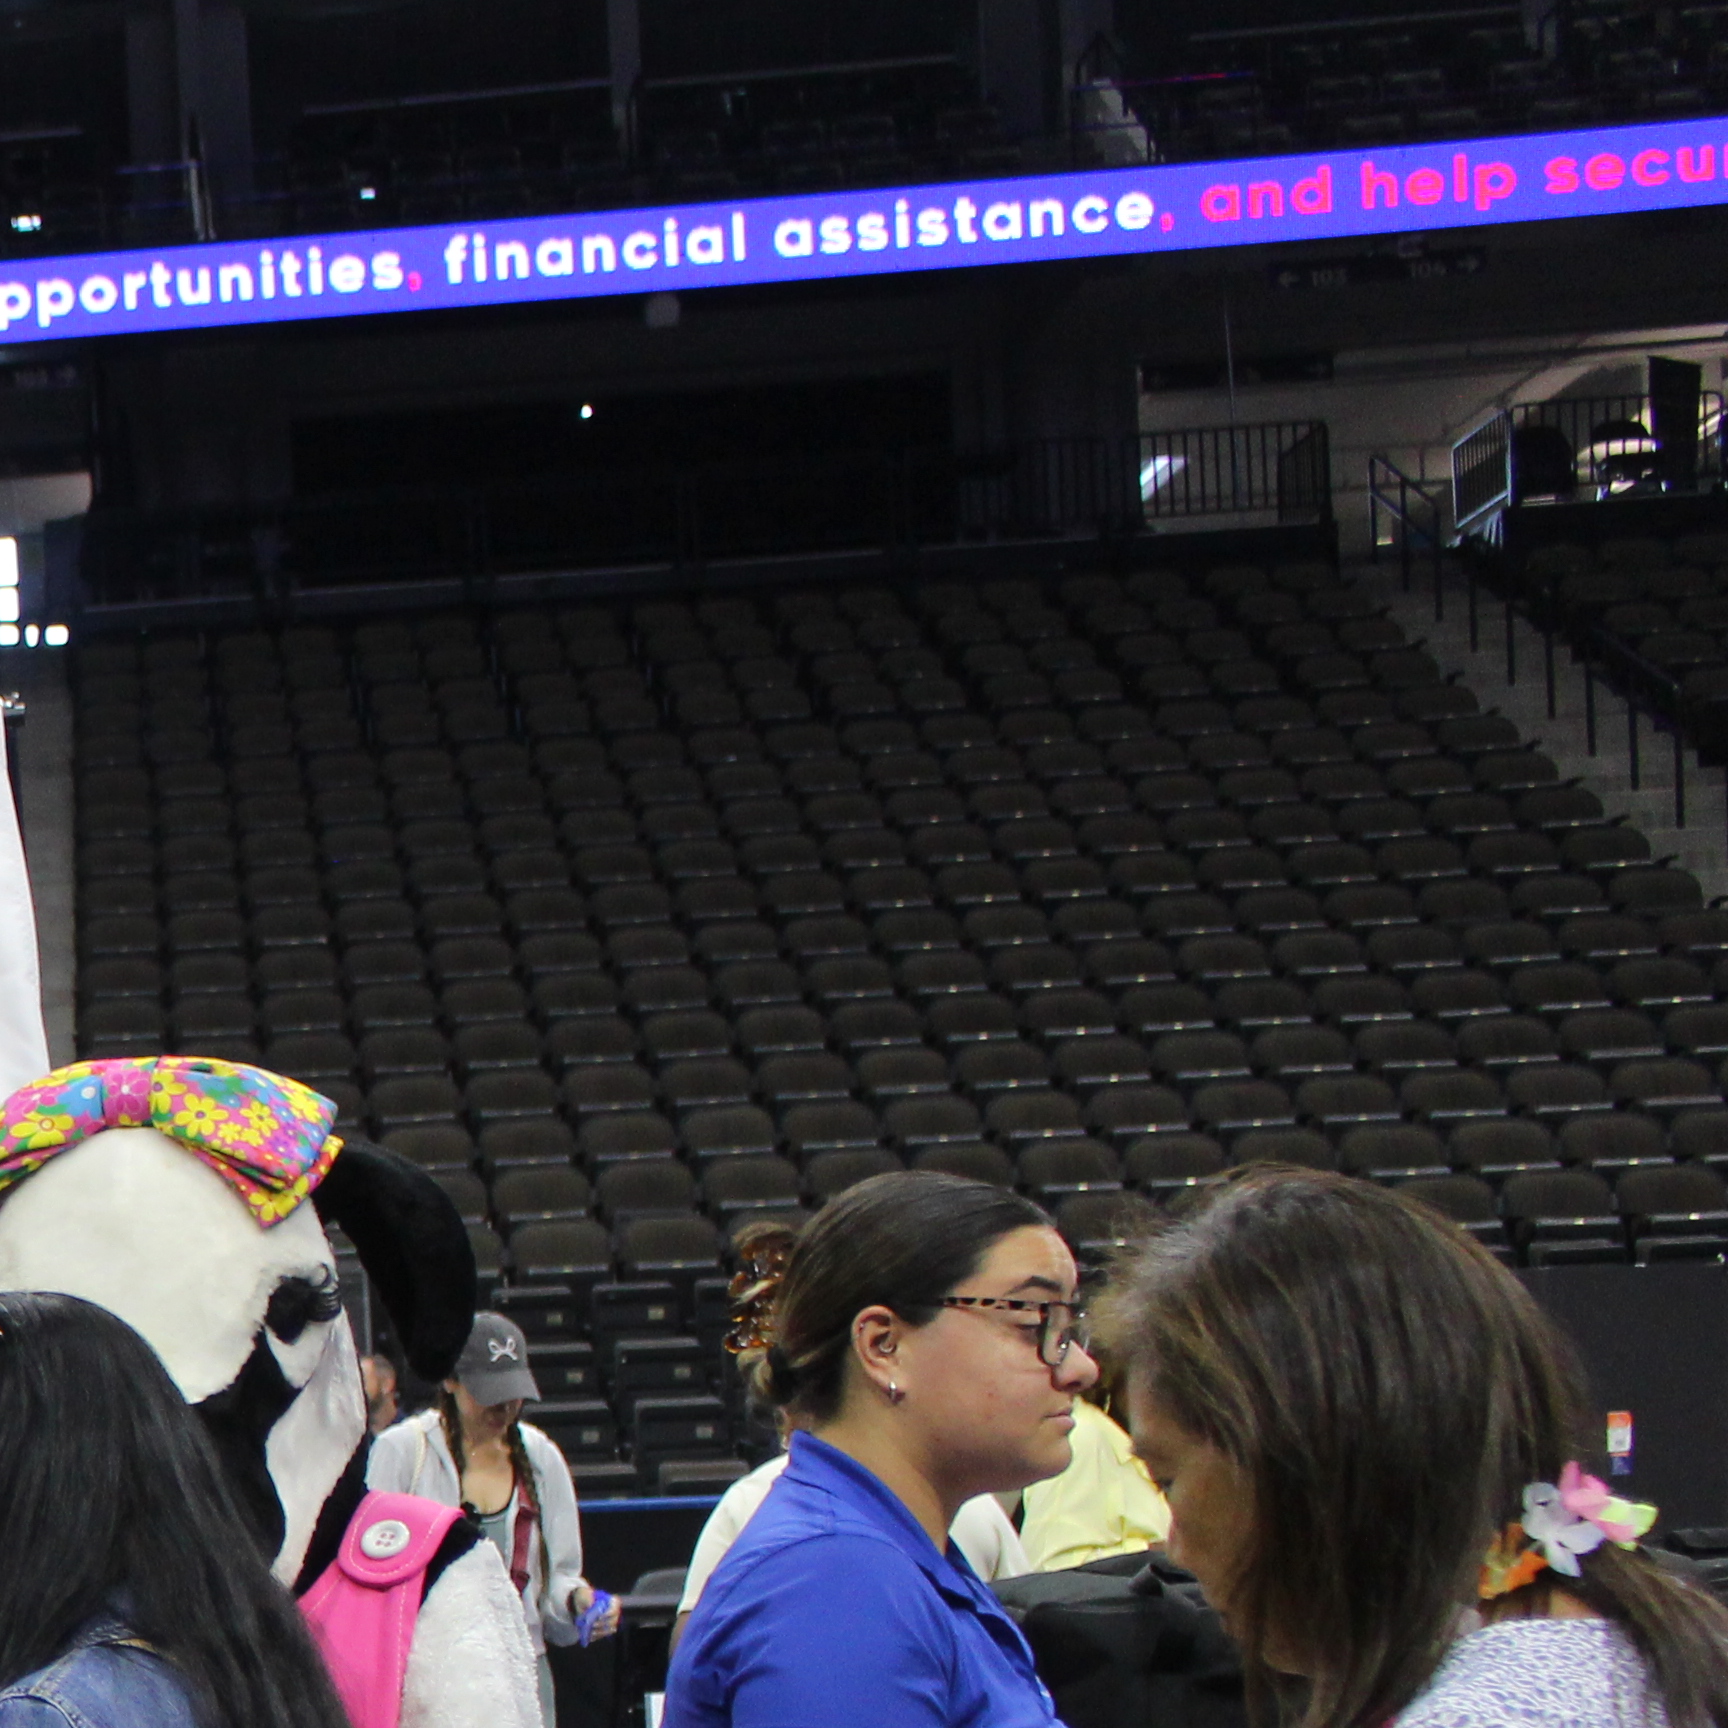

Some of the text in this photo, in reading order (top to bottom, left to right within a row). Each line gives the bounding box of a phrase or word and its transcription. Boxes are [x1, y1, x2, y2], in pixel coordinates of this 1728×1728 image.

[443, 219, 747, 284] financial
[773, 190, 1176, 257] assistance,
[1198, 163, 1334, 223] and
[1359, 152, 1519, 212] help
[1544, 143, 1728, 194] secu
